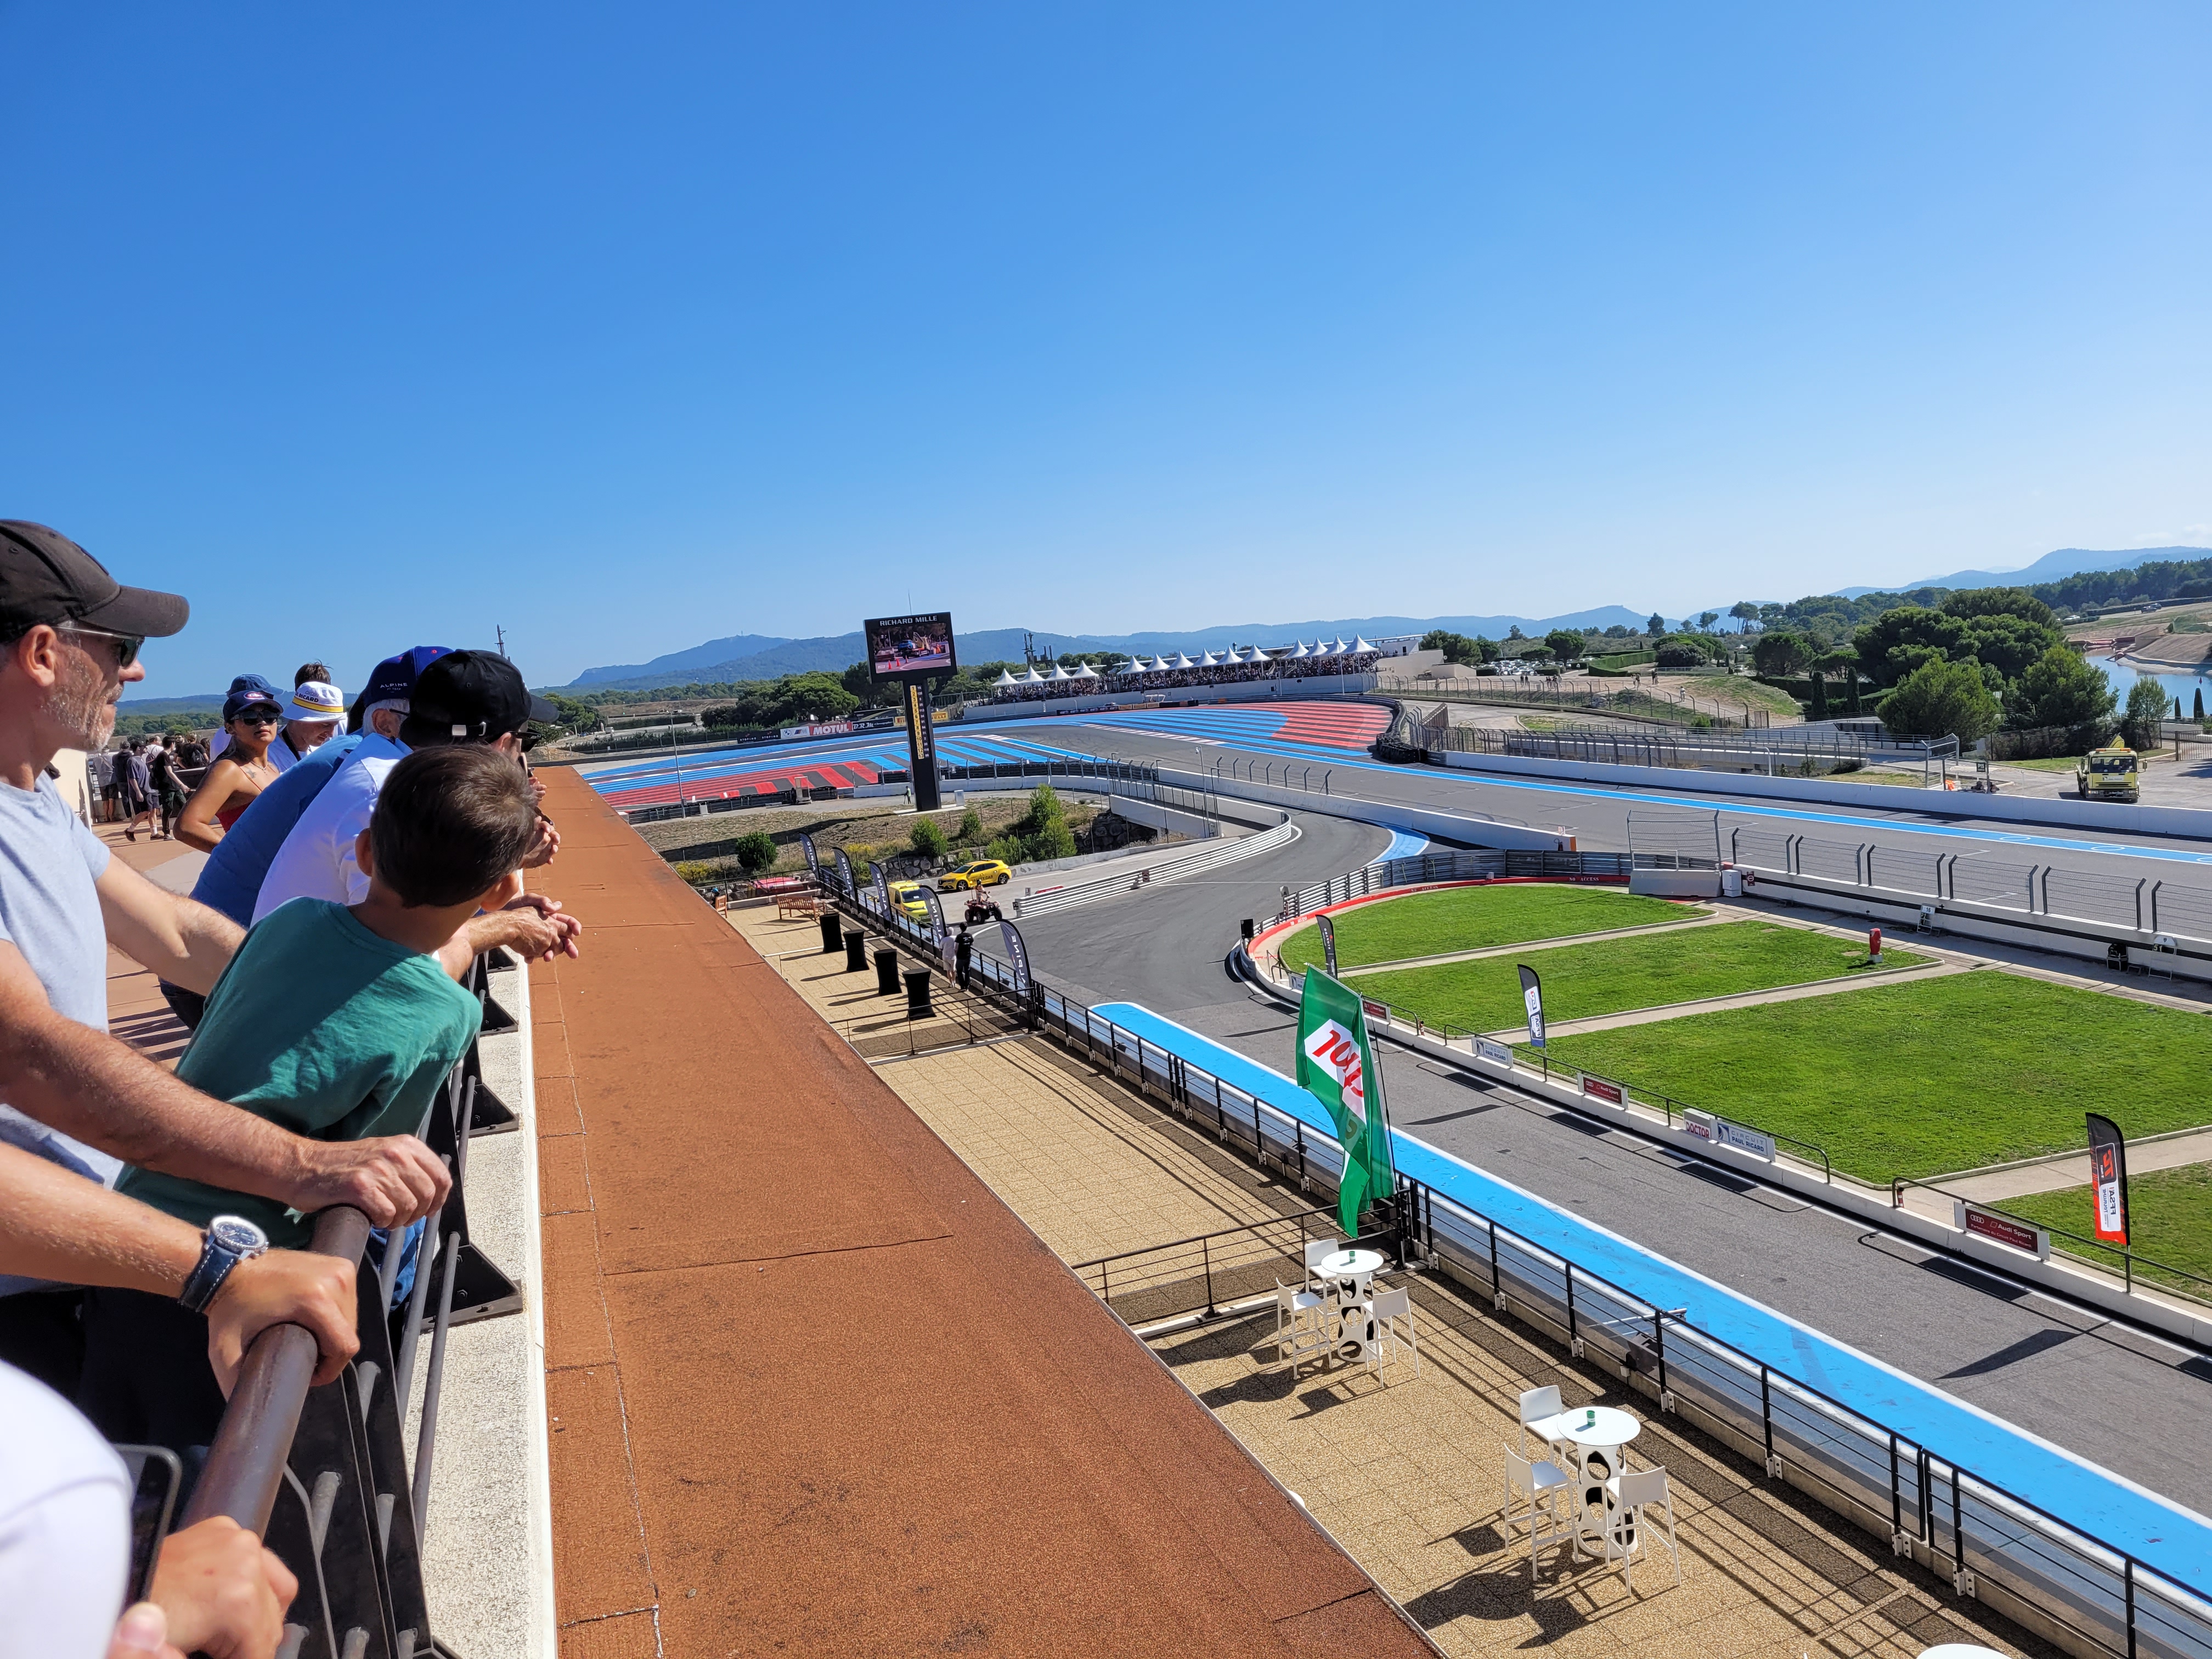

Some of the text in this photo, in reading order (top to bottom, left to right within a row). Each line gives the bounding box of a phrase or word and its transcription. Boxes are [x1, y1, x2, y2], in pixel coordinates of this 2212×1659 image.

[879, 618, 913, 626] RICHARD
[298, 693, 319, 702] RICARD
[813, 724, 849, 735] MOTUL
[2153, 944, 2163, 952] 51
[1685, 1121, 1709, 1139] DOCTOR
[1731, 1130, 1764, 1144] CIRCUIT
[1731, 1136, 1764, 1152] PAUL RICARD
[1997, 1223, 2032, 1240] Audi Sport
